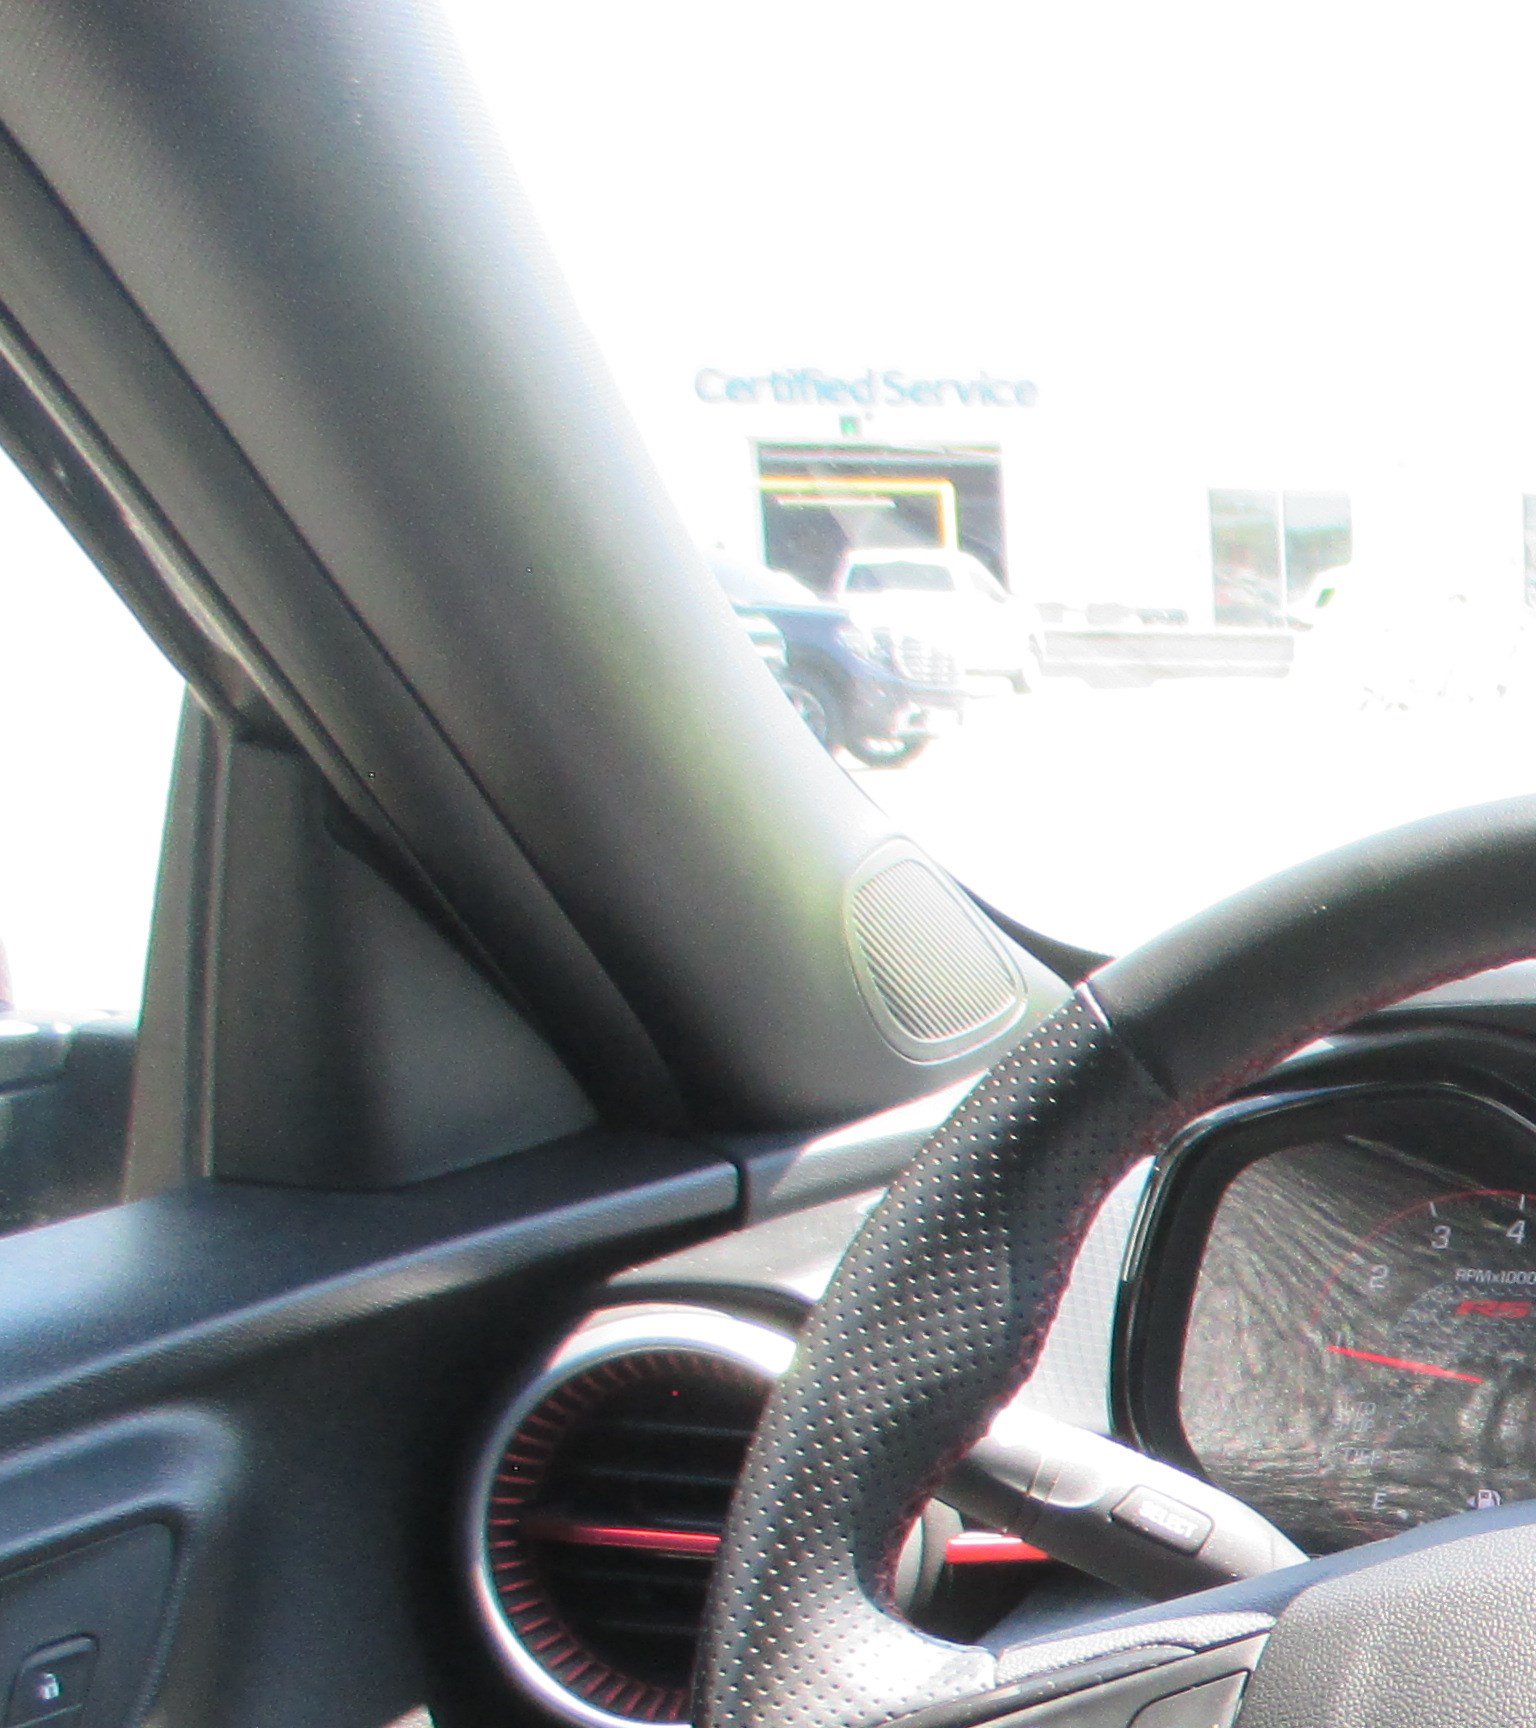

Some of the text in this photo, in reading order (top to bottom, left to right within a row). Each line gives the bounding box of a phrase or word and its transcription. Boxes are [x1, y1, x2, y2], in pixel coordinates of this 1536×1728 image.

[695, 367, 1039, 407] Certified Service
[1432, 1225, 1452, 1250] 3
[1505, 1219, 1527, 1245] 4
[1369, 1264, 1390, 1289] 2
[1455, 1299, 1531, 1319] RS
[1139, 1502, 1198, 1538] SELECT
